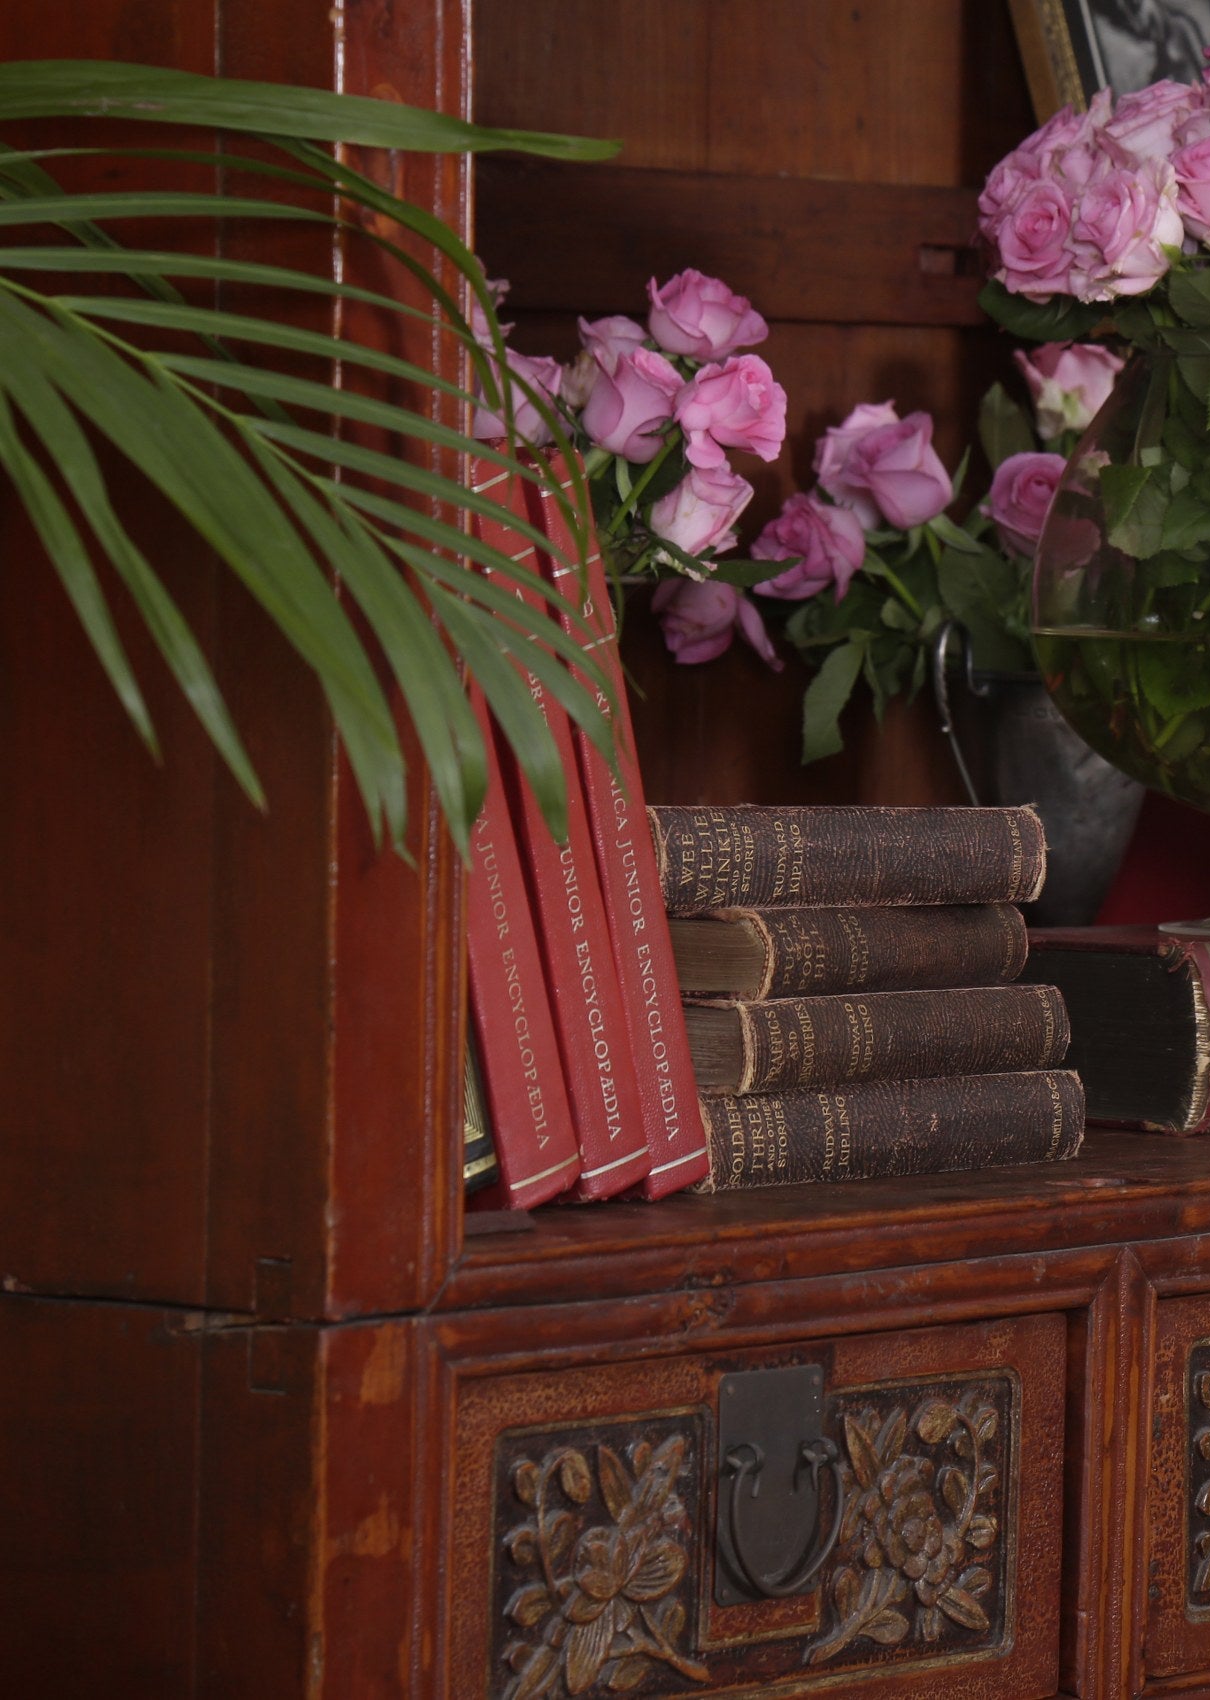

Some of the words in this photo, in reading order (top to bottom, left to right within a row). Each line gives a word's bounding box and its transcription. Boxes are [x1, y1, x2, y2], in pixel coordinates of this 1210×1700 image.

[680, 833, 695, 886] WEE
[694, 815, 713, 901] WILLIE
[710, 812, 731, 904] WINKIE
[730, 822, 741, 862] OTHER
[741, 826, 754, 892] STORIES
[773, 821, 787, 897] RUDYARD
[790, 824, 803, 892] KIPLING
[731, 870, 741, 895] AND
[554, 833, 585, 934] UNIOR
[576, 939, 622, 1142] ENCYCLOPÆDIA
[775, 922, 794, 984] PUCK
[477, 842, 510, 940] JUNIOR
[502, 947, 551, 1150] ENCYCLOPÆDIA
[616, 840, 646, 936] JUNIOR
[638, 943, 680, 1142] ENCYCLOPÆDIA
[765, 1010, 784, 1082] TRAFFICS
[789, 1031, 799, 1061] AND
[794, 1003, 815, 1083] DISCOVERIES
[844, 1003, 860, 1077] RUDYARD
[858, 1004, 874, 1073] KIPLING
[744, 1095, 765, 1173] THREE
[767, 1144, 776, 1171] AND
[773, 1100, 788, 1168] STORIES
[819, 1094, 834, 1171] RUDYARD
[836, 1096, 850, 1166] KIPLING
